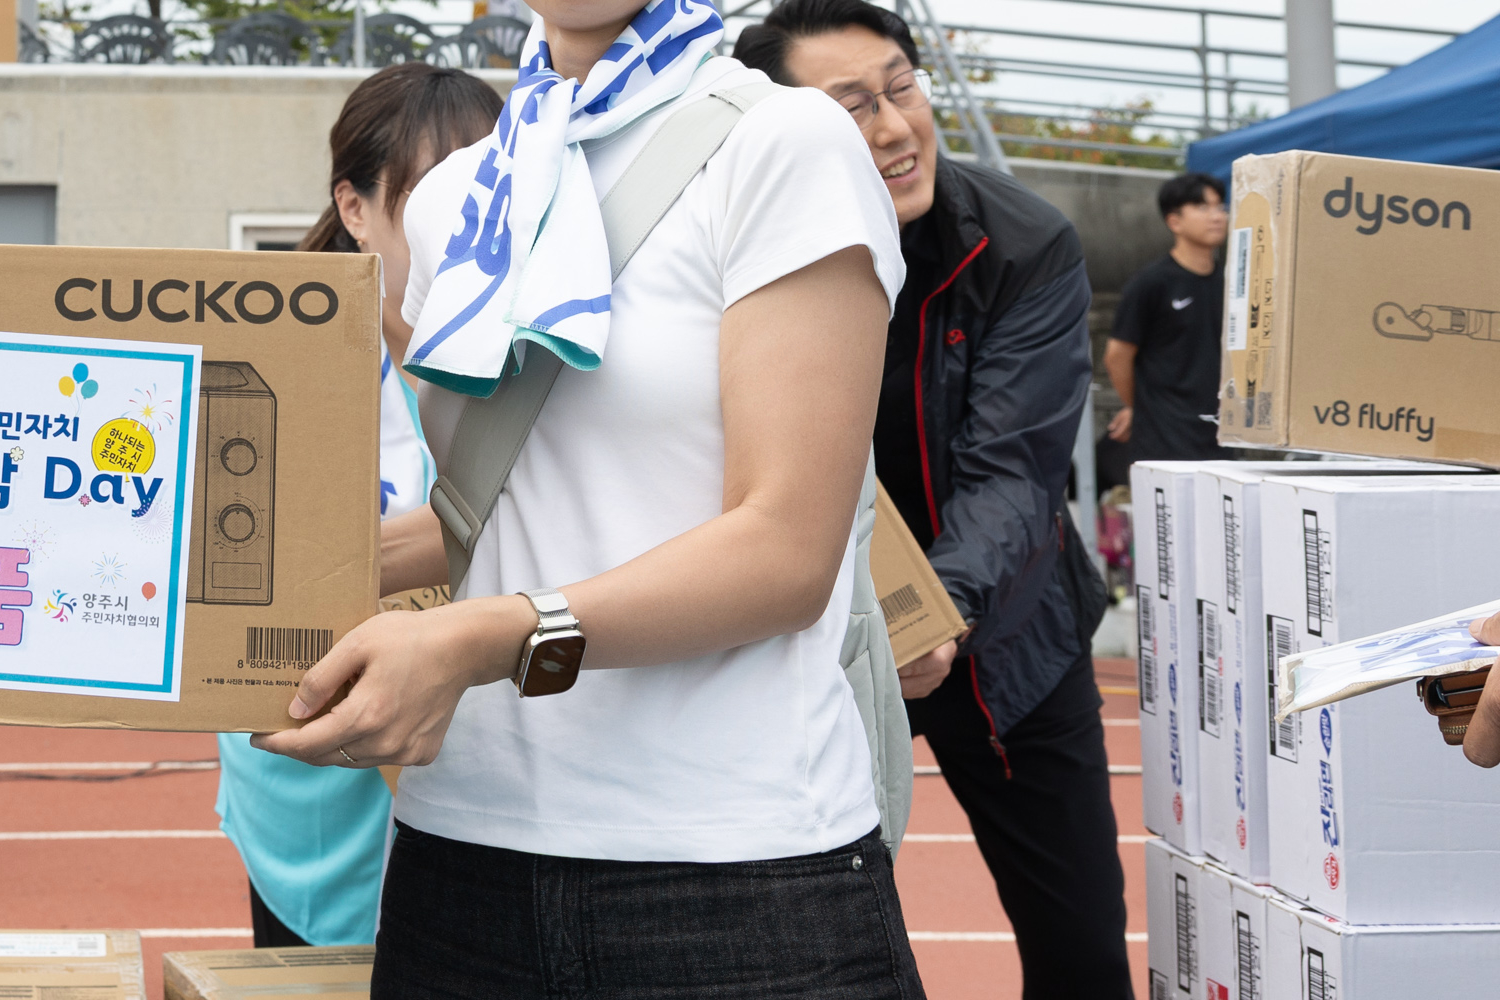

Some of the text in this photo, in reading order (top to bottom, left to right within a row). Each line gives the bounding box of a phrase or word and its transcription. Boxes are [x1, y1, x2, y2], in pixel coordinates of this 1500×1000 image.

[1323, 177, 1472, 236] dyson
[54, 277, 339, 326] CUCKOO
[1313, 400, 1435, 442] v8 fluffy
[109, 428, 146, 453] 하나되는
[99, 448, 137, 473] 주민자치
[43, 455, 164, 518] Day
[82, 593, 129, 612] 양주시
[81, 611, 161, 628] 주민자치협의회
[237, 659, 244, 669] 8
[250, 660, 287, 670] 809421
